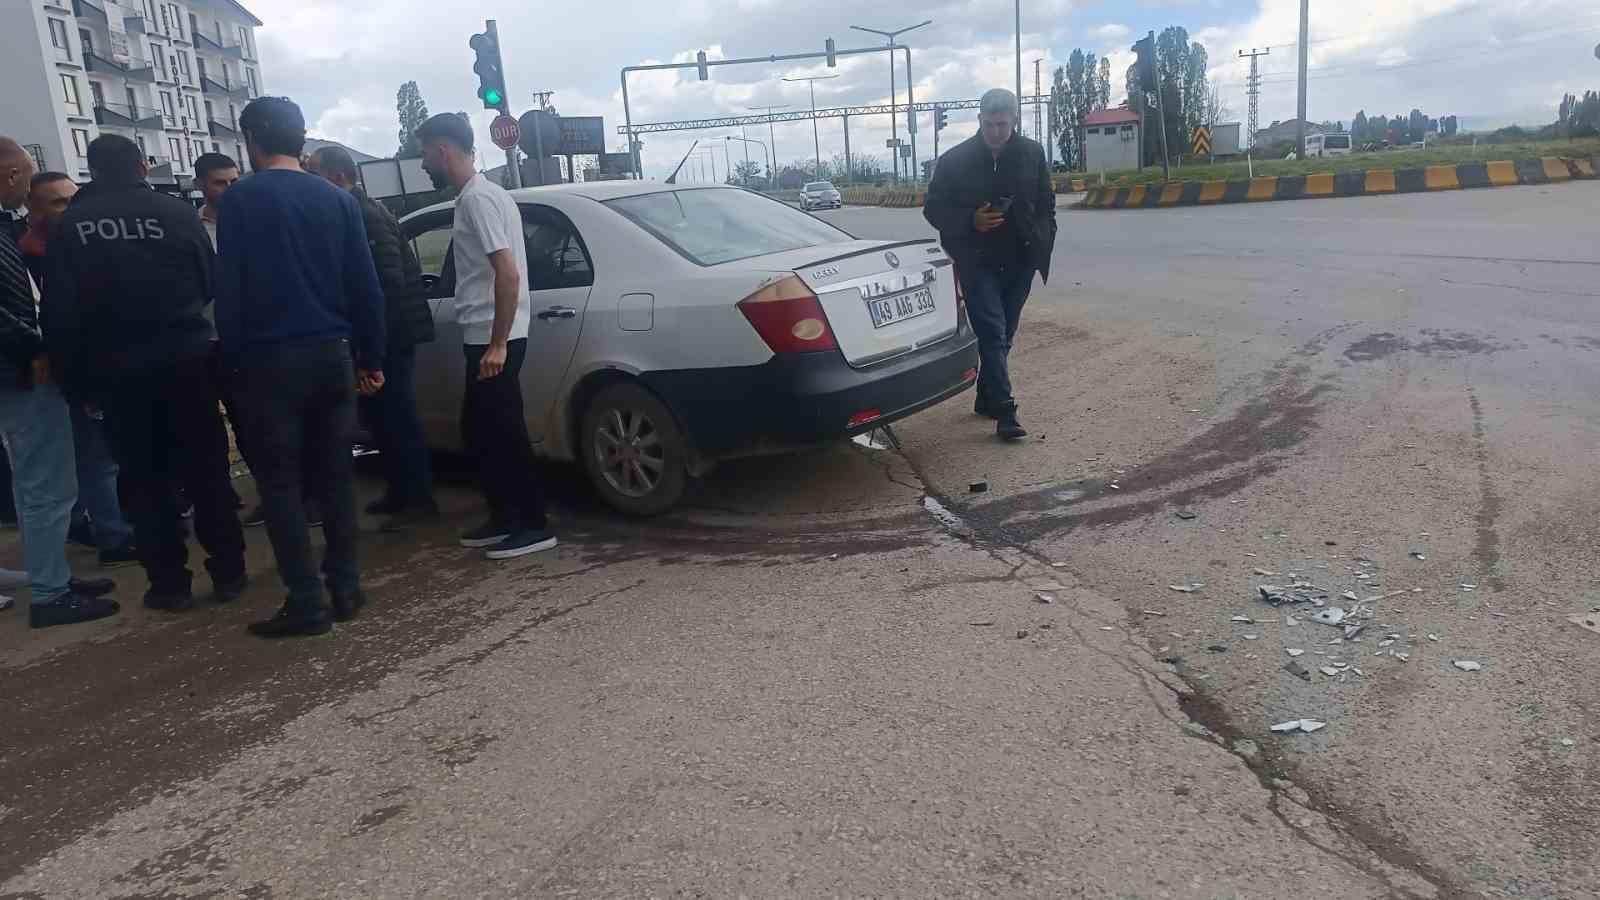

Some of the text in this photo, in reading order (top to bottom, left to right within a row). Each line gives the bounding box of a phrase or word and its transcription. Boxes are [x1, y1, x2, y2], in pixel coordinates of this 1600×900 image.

[494, 125, 518, 139] DUR
[880, 301, 892, 321] 49
[895, 295, 913, 319] AAG
